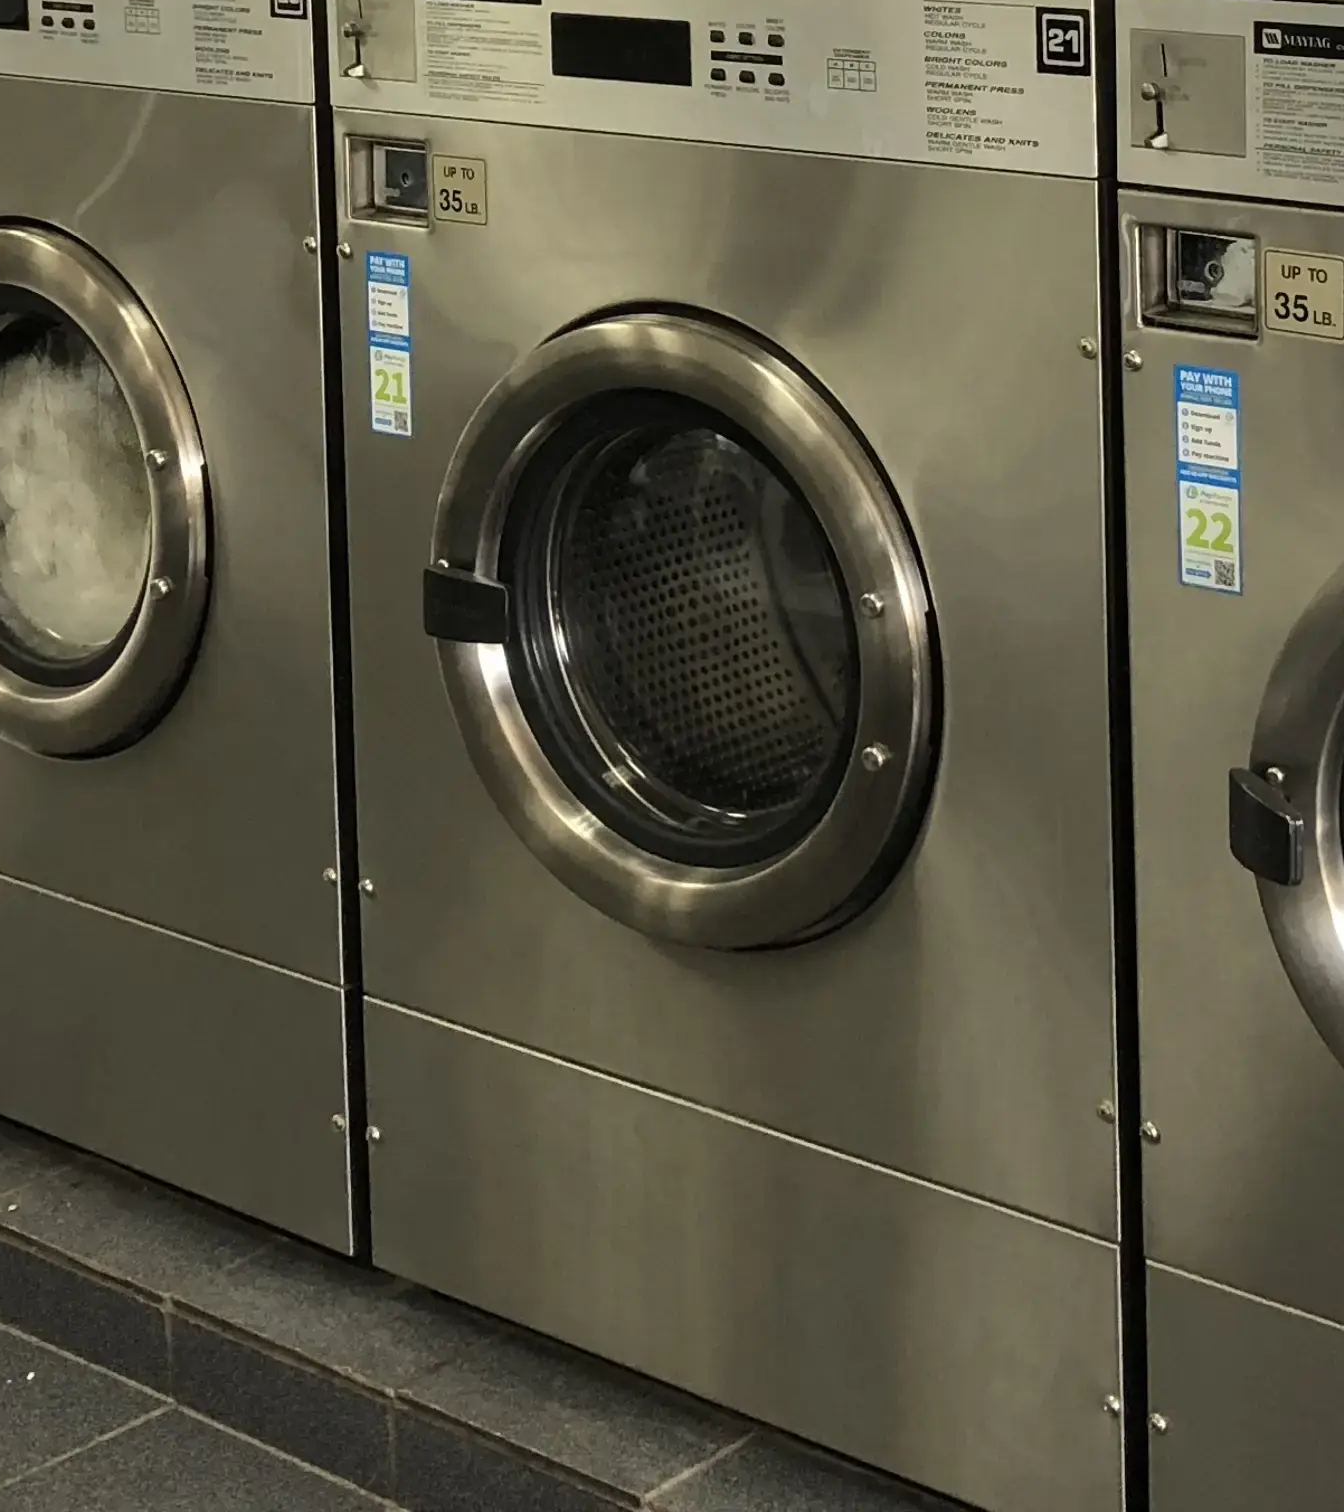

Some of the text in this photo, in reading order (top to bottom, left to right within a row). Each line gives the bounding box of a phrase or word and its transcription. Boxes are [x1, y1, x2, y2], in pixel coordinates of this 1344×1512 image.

[923, 5, 961, 13] WHITES
[924, 31, 965, 39] COLORS
[1048, 28, 1079, 54] 21
[1283, 35, 1331, 48] MAYTAG
[925, 56, 1007, 68] BRIGHT COLORS
[925, 81, 1024, 94] PERMANENT PRESS
[927, 106, 976, 116] WOOLENS
[926, 131, 981, 142] DELICATES
[1008, 139, 1039, 147] KNITS
[444, 166, 475, 180] UP TO
[440, 189, 463, 212] 35
[1281, 264, 1327, 283] UP TO
[1275, 292, 1336, 327] 35 LB.
[1180, 370, 1232, 387] PAY WITH
[375, 369, 407, 404] 21
[1181, 382, 1232, 397] YOUR PHONE
[1186, 508, 1233, 553] 22
